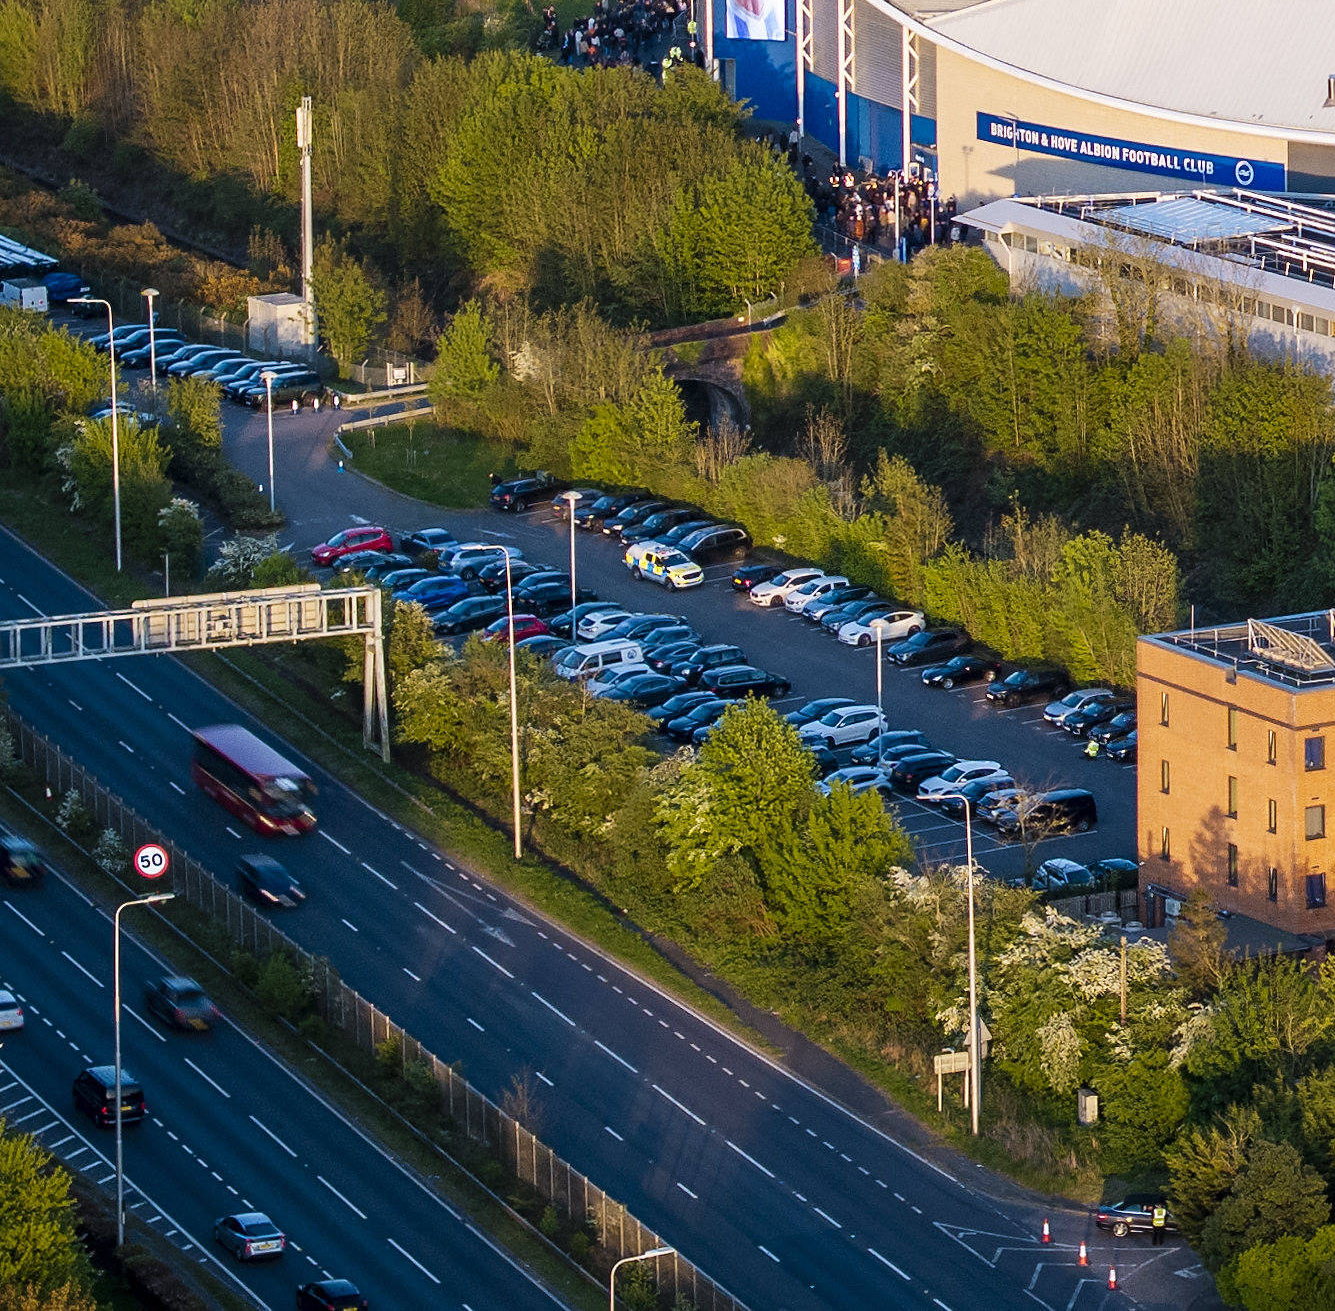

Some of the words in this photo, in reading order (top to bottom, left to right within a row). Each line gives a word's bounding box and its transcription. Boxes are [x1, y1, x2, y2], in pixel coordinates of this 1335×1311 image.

[990, 122, 1039, 145] BRIGHTON
[1040, 133, 1048, 147] &
[1050, 134, 1078, 153] HOVE
[1080, 141, 1120, 161] ALBION
[1122, 147, 1181, 170] FOOTBALL
[1183, 157, 1214, 175] CLUB
[141, 853, 163, 868] 50
